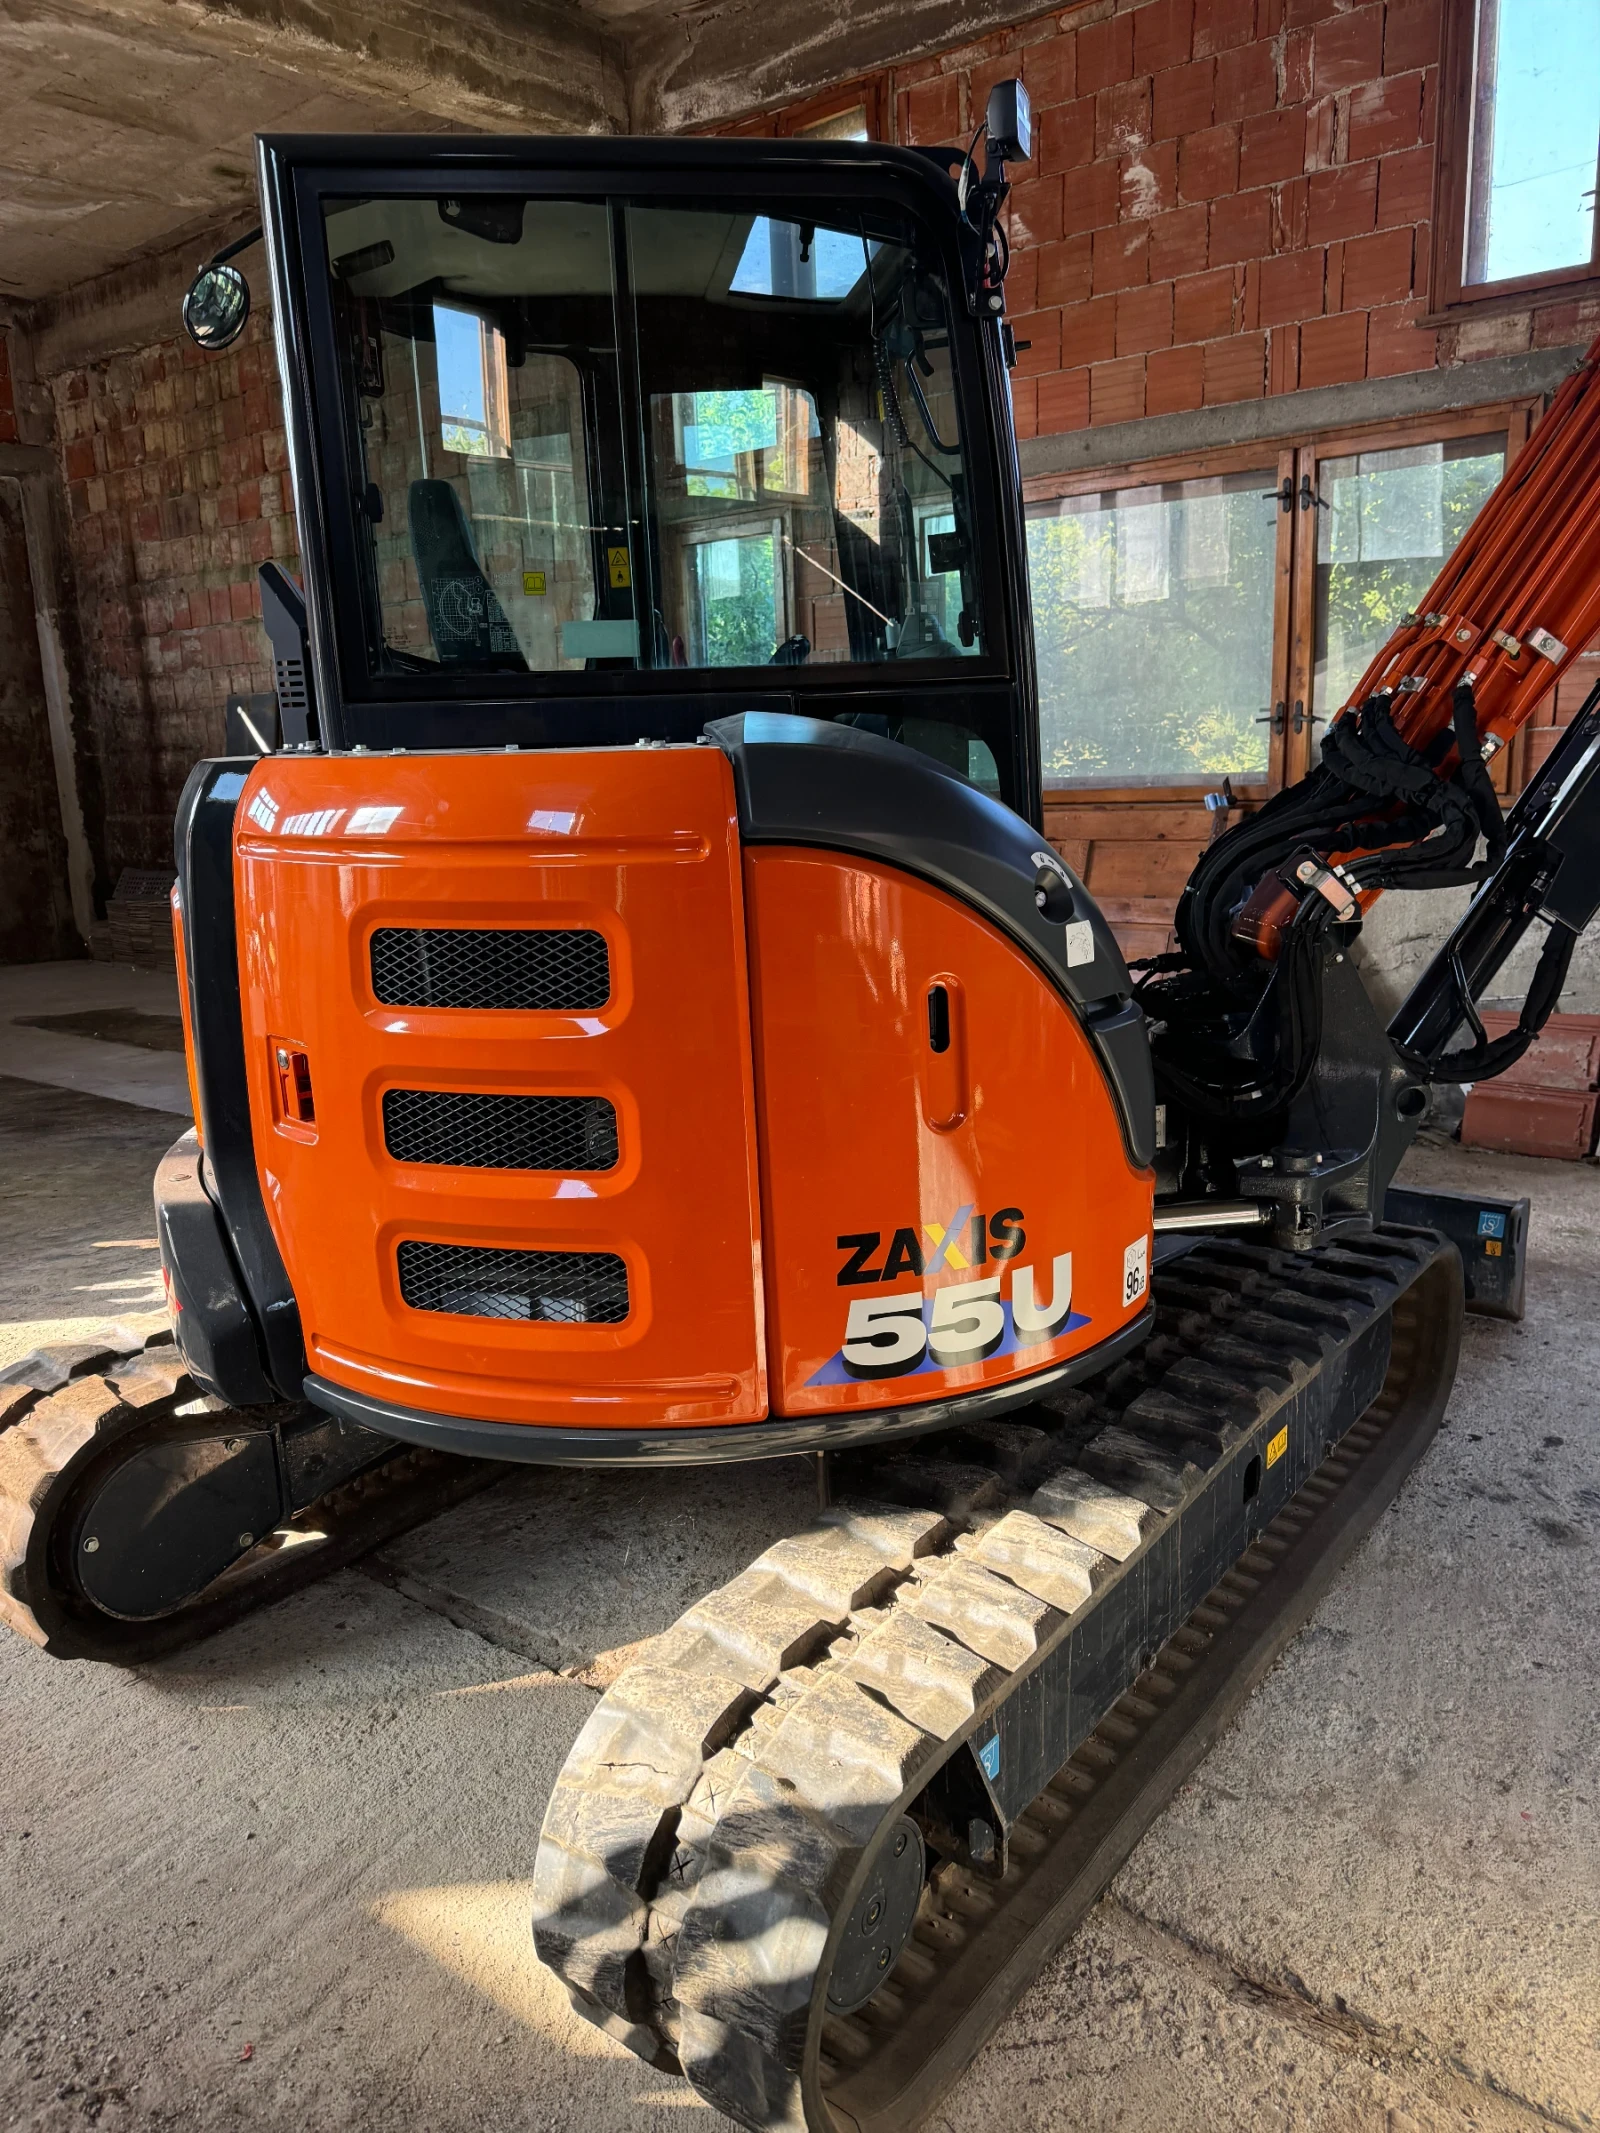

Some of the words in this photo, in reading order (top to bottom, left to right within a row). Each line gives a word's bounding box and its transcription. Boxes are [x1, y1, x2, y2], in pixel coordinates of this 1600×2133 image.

[837, 1204, 1026, 1286] ZAXIS
[1126, 1267, 1139, 1300] 96
[841, 1251, 1073, 1379] 55U
